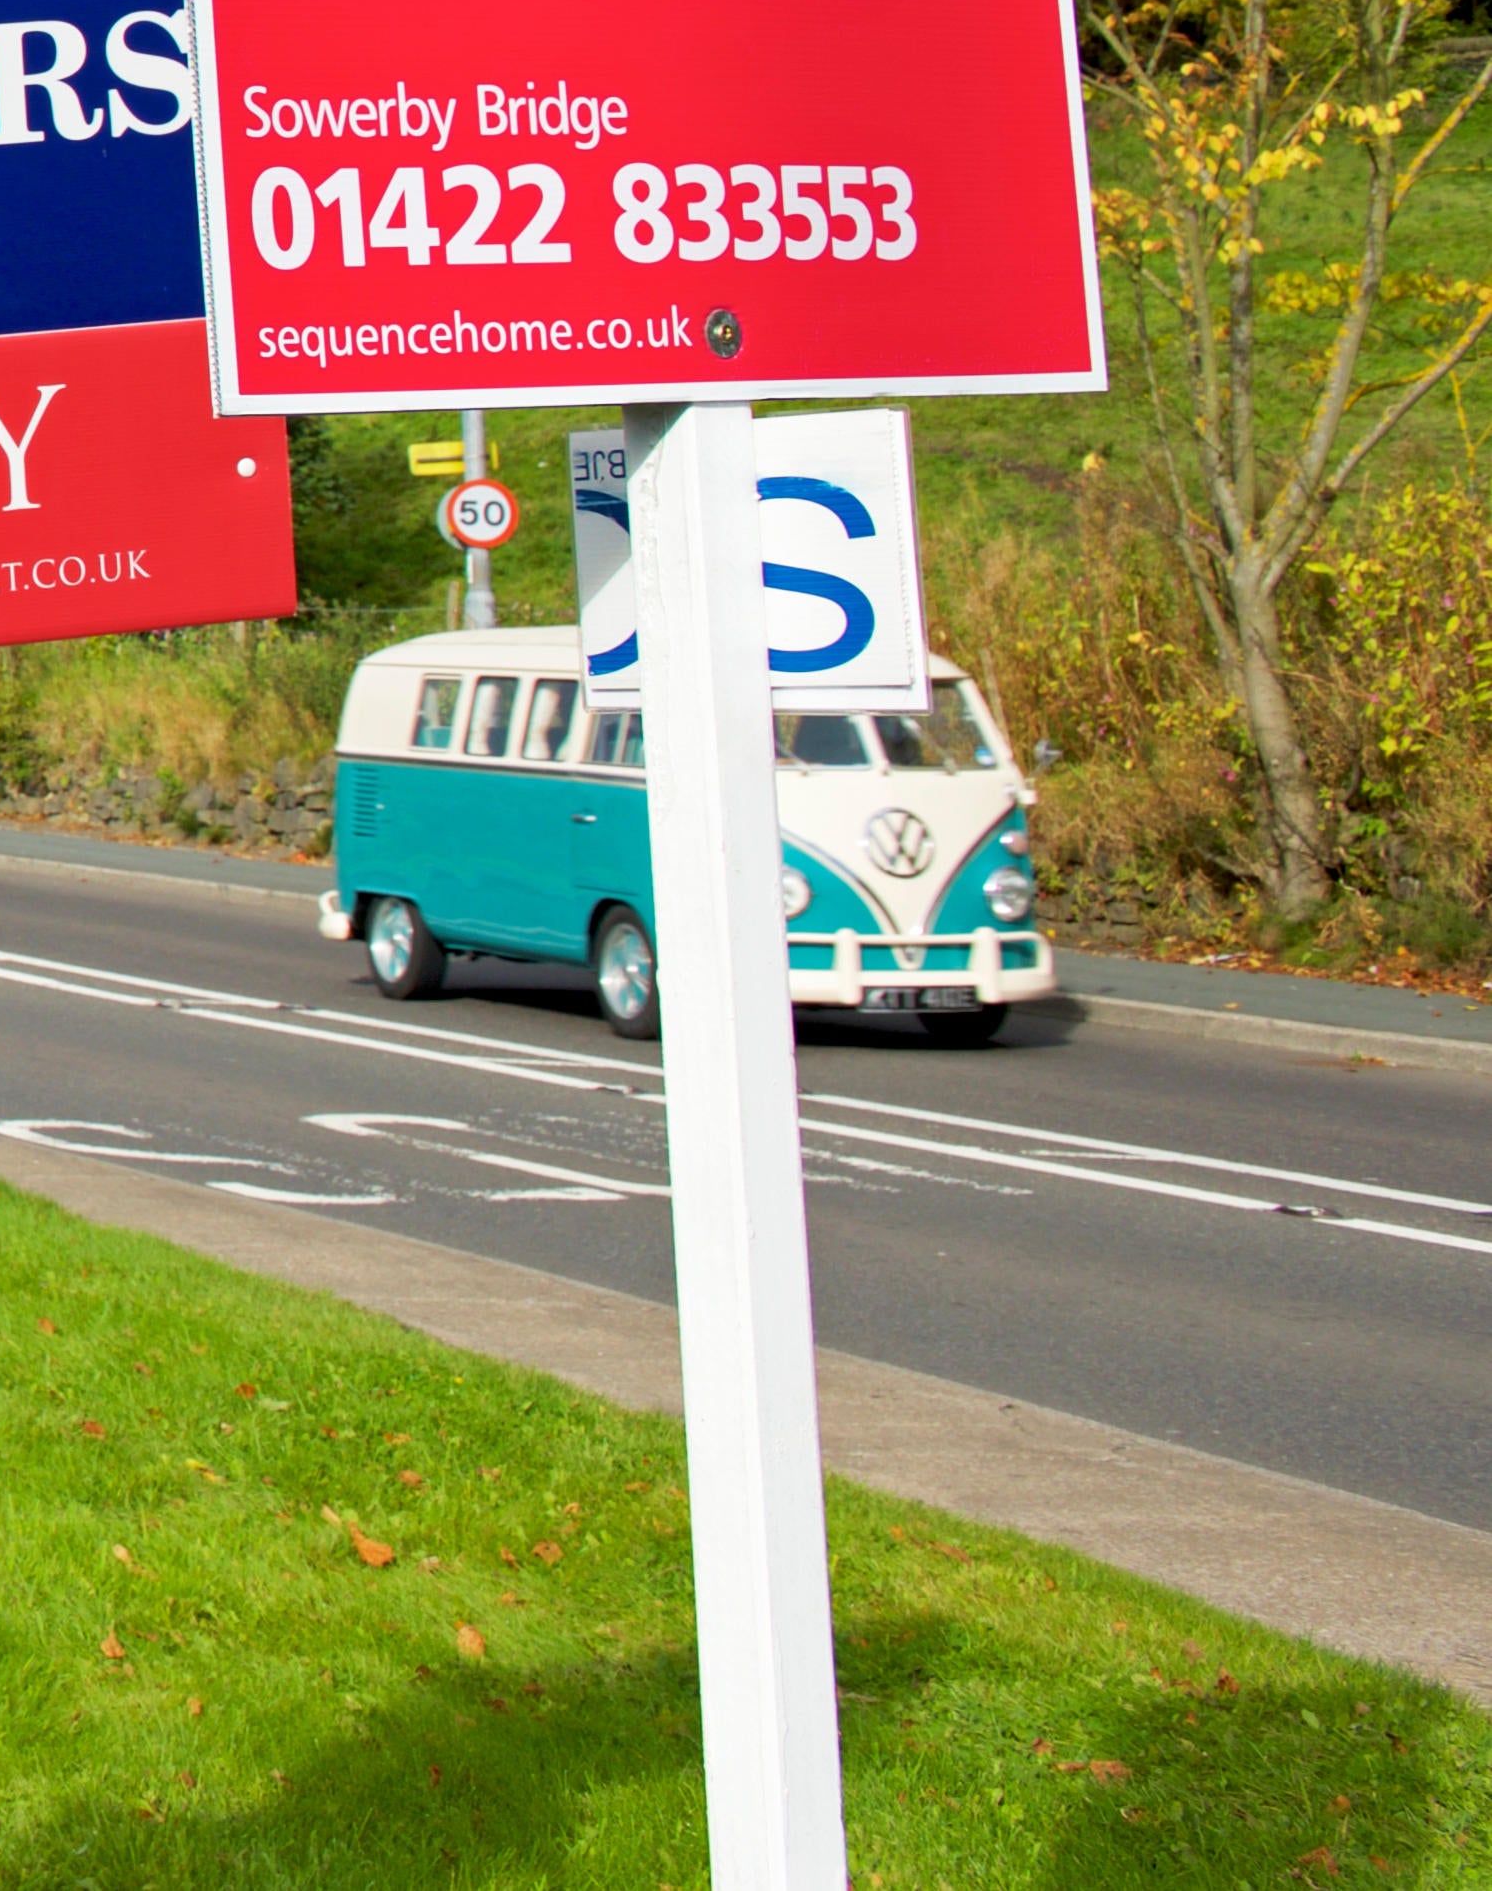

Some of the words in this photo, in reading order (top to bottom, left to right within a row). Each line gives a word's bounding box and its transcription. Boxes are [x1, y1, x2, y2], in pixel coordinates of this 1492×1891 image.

[243, 82, 457, 150] Sowerby
[477, 81, 628, 149] Bridge
[252, 164, 572, 271] 01422
[613, 163, 917, 264] 833553
[258, 305, 692, 364] sequencehome.co.uk
[460, 501, 506, 526] 50
